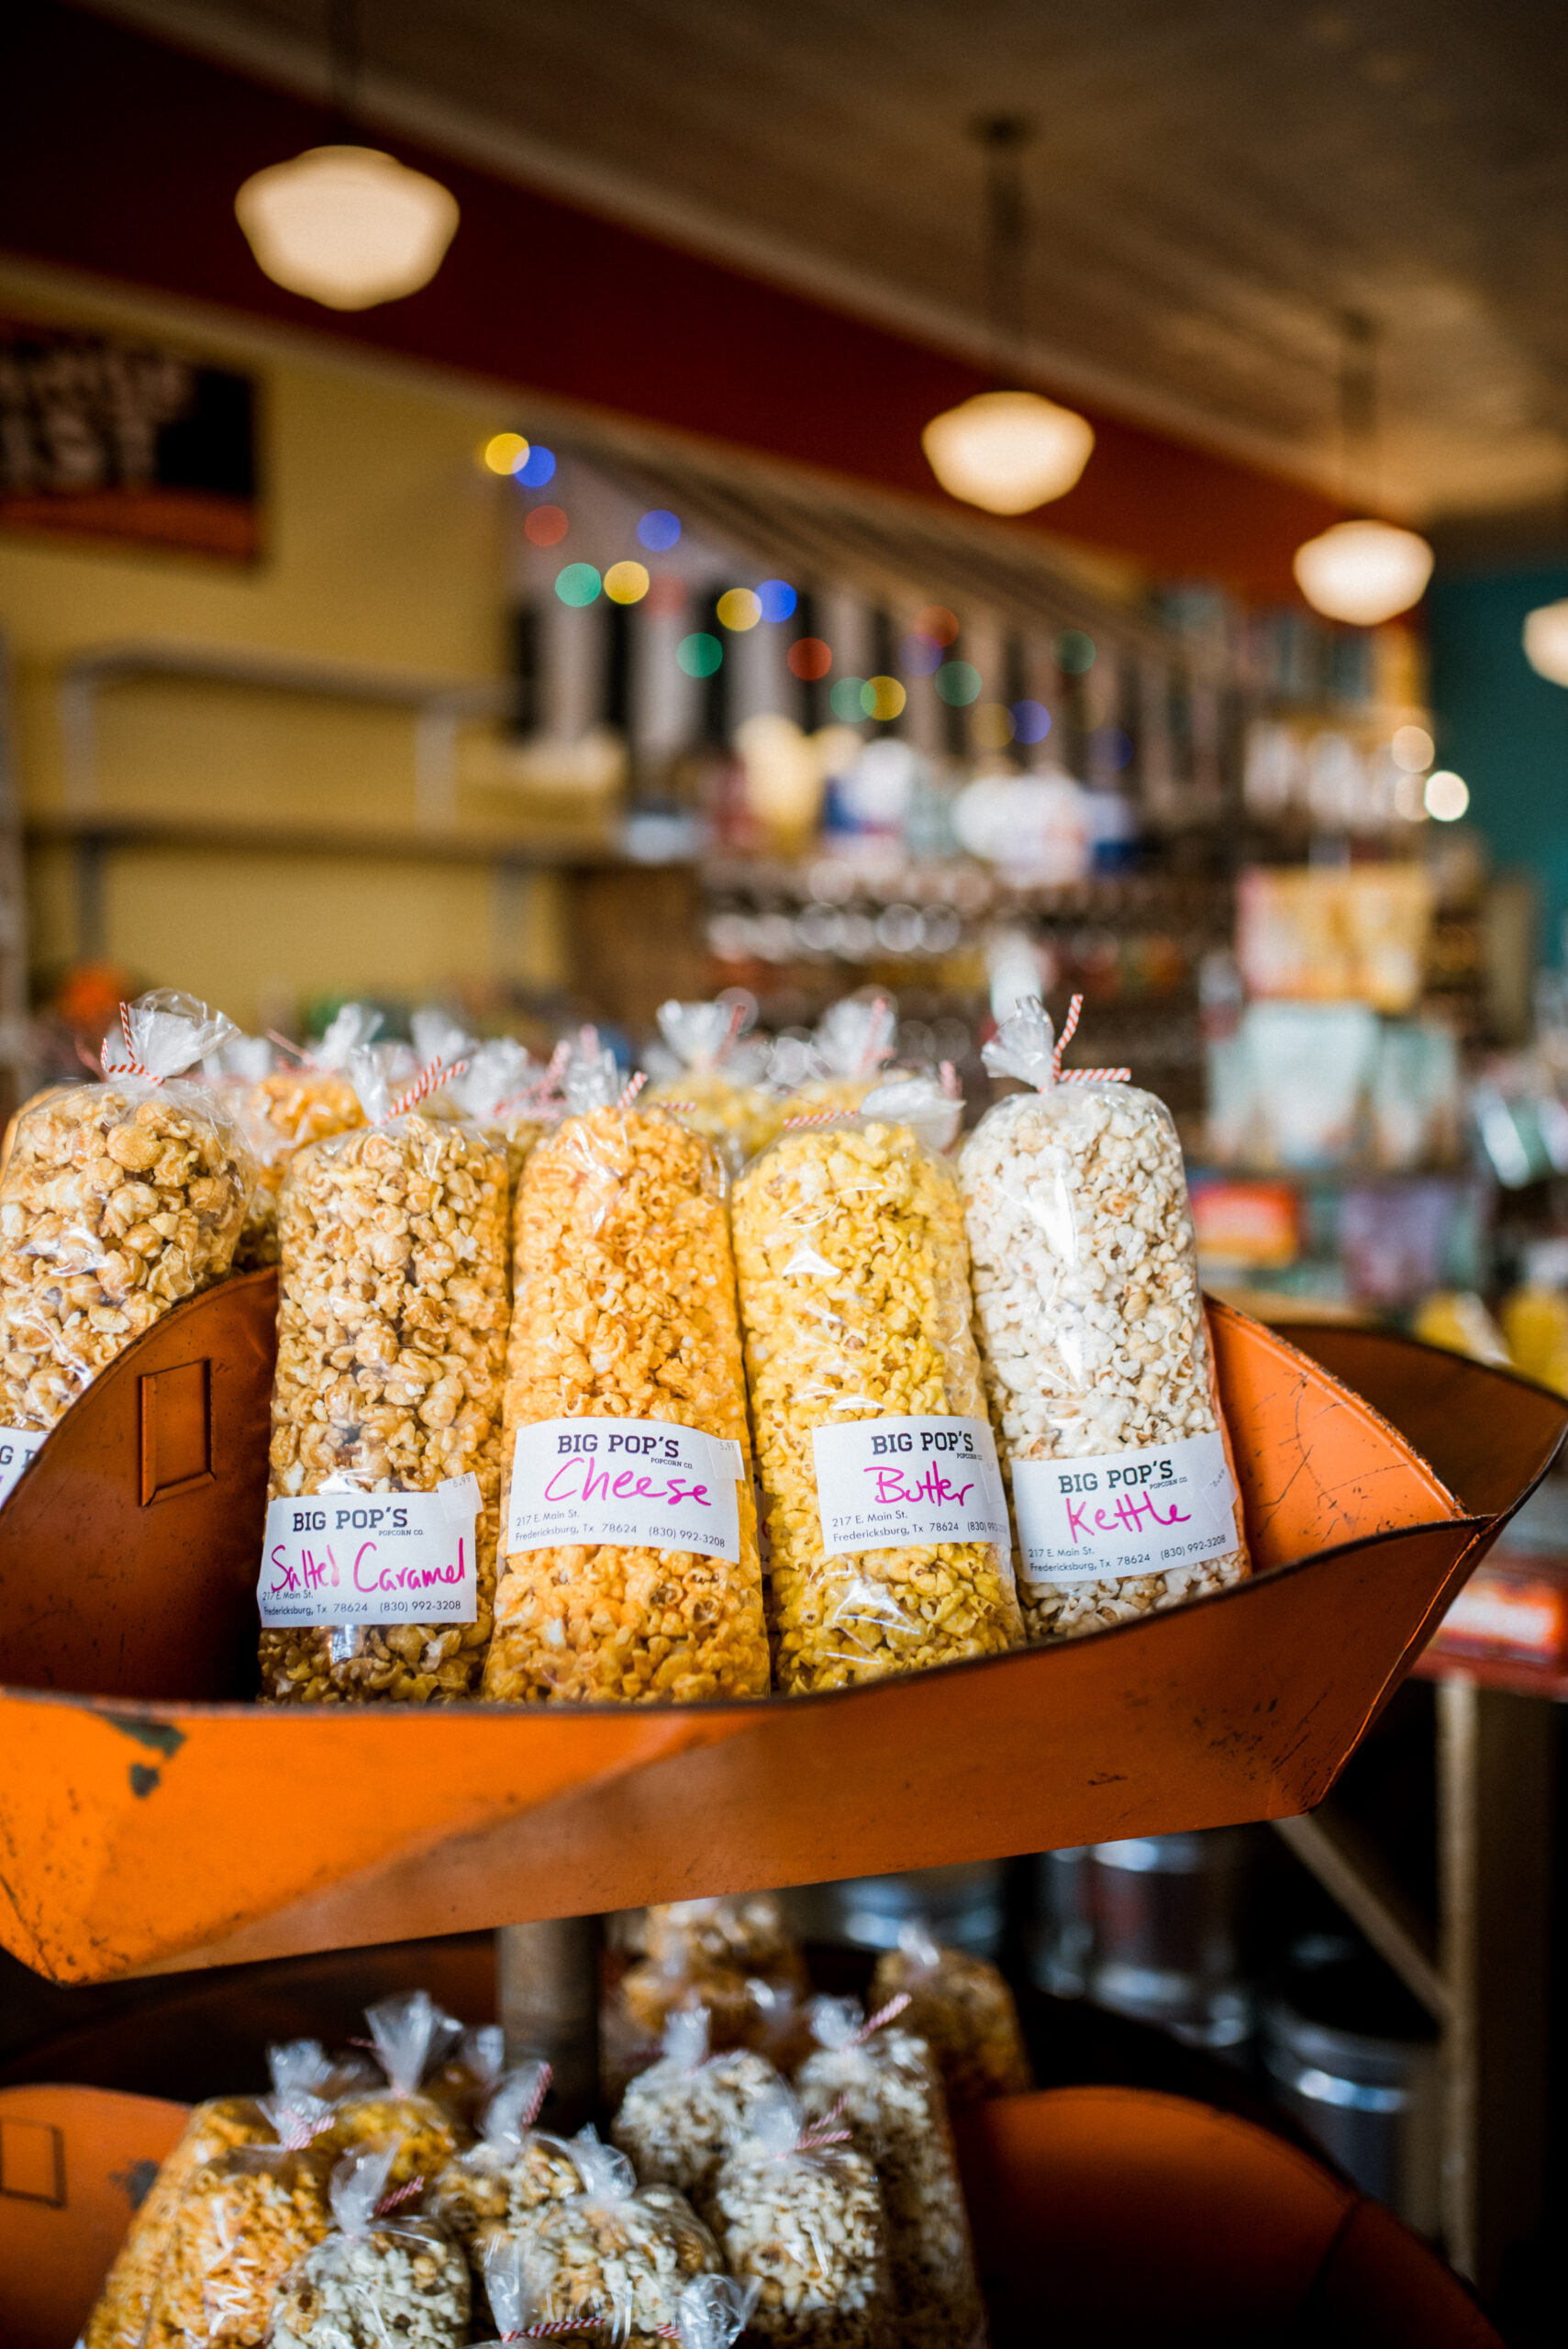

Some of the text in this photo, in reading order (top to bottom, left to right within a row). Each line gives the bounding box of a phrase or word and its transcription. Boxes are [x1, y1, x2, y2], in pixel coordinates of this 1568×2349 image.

[557, 1434, 679, 1458] BIG POP'S
[872, 1431, 973, 1454] BIG POP'S
[651, 1457, 682, 1467] POPCORN
[544, 1456, 712, 1506] Cheese
[863, 1460, 974, 1507] Butter
[1058, 1460, 1173, 1494] BIG POP'S
[293, 1507, 408, 1531] BIG POP'S
[517, 1515, 531, 1527] 217
[543, 1510, 565, 1520] Main
[832, 1517, 851, 1527] 217
[867, 1512, 892, 1522] Main
[895, 1509, 907, 1520] St.
[1065, 1491, 1191, 1543] Kettle
[584, 1523, 594, 1533] Tx
[602, 1523, 638, 1533] 78624
[649, 1526, 676, 1539] (830)
[680, 1530, 725, 1548] 992-3208
[833, 1527, 909, 1542] Fredericksburg,
[912, 1524, 924, 1533] Tx
[929, 1521, 959, 1531] 78624
[1029, 1549, 1044, 1558] 217
[1058, 1548, 1079, 1556] Main
[1099, 1559, 1111, 1567] Tx
[1117, 1553, 1151, 1565] 78624
[1161, 1546, 1185, 1560] (830)
[1187, 1534, 1226, 1553] 992-3208
[271, 1537, 465, 1593] Salted Caramel
[283, 1591, 301, 1599] Main
[303, 1589, 314, 1599] St.
[317, 1604, 327, 1613] Tx
[333, 1603, 367, 1613] 78624
[379, 1601, 407, 1613] (830)
[411, 1600, 462, 1611] 992-3208
